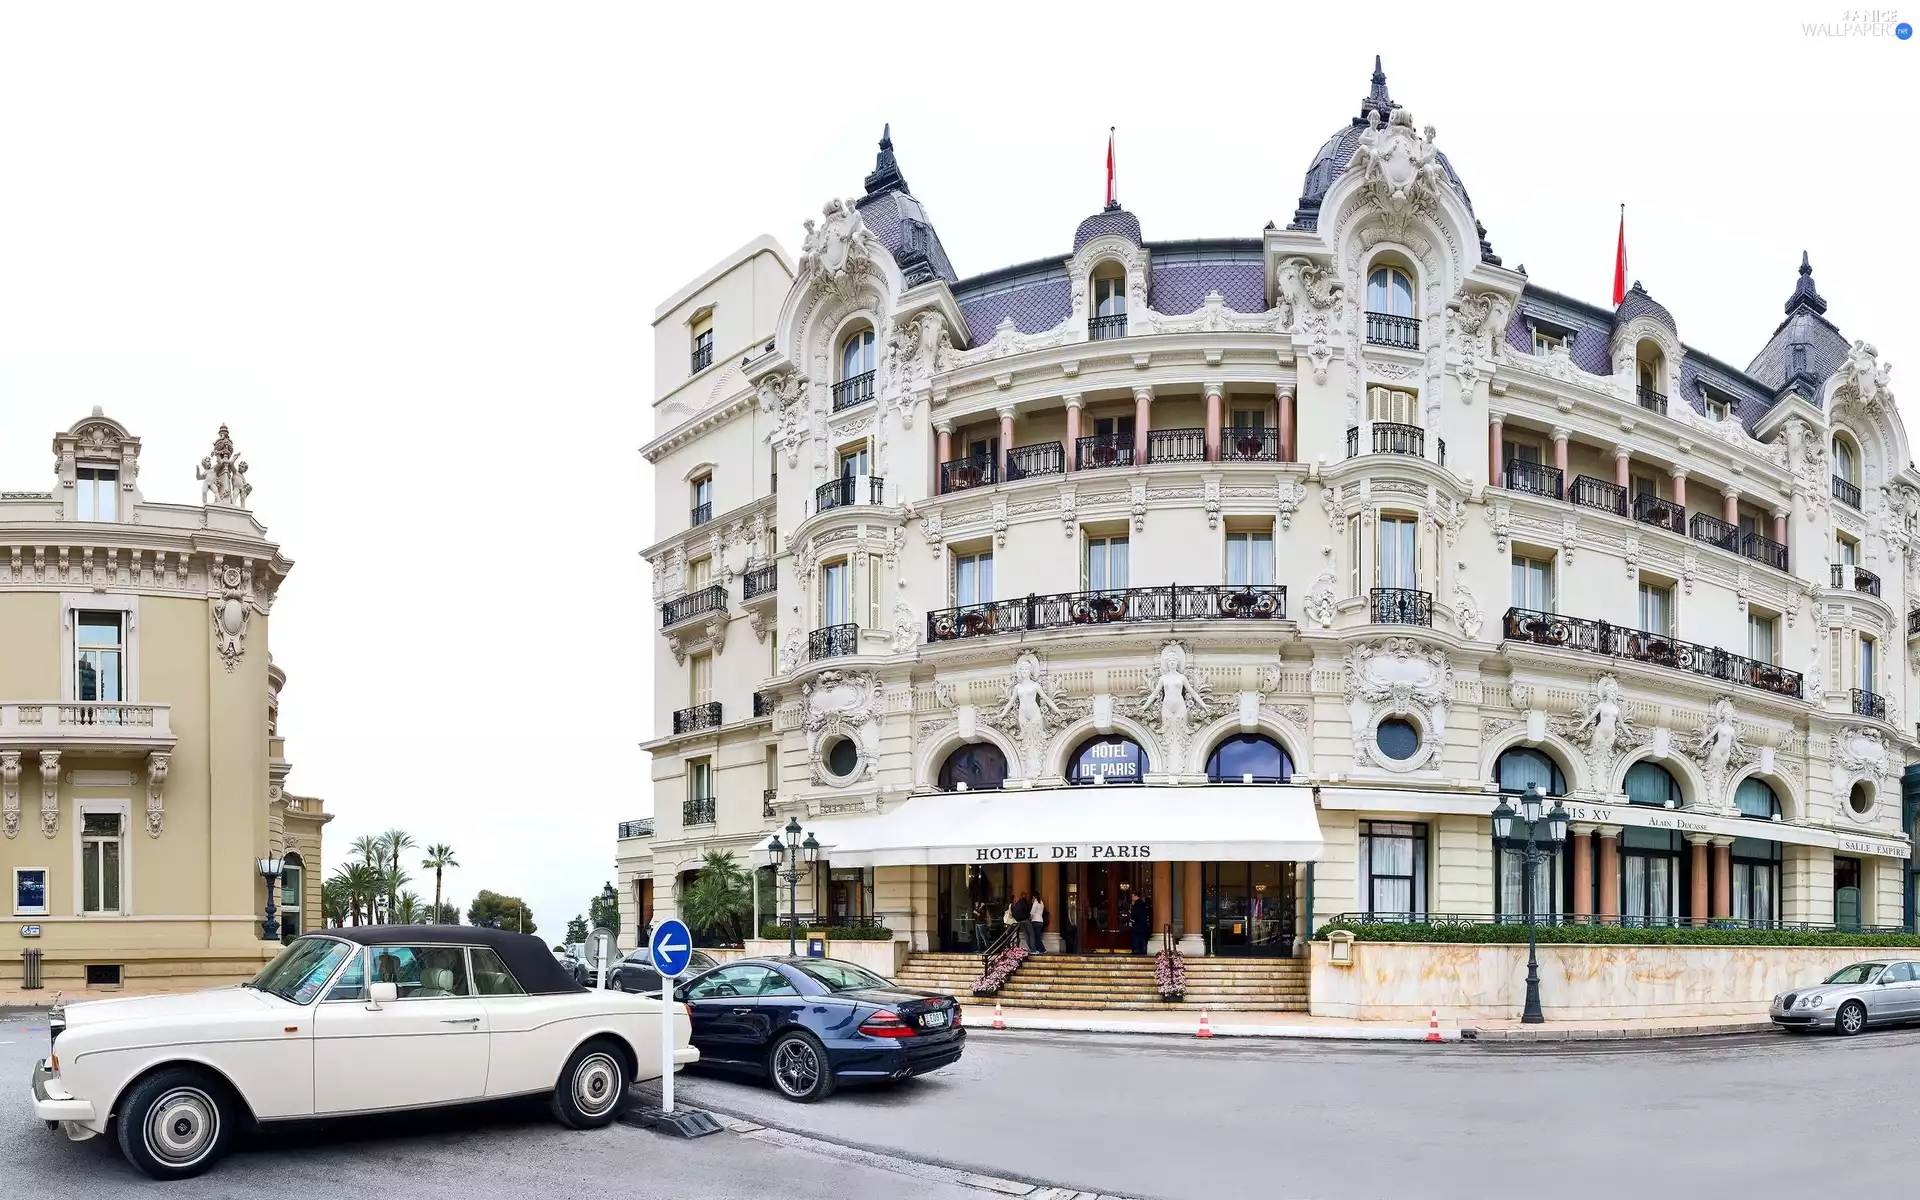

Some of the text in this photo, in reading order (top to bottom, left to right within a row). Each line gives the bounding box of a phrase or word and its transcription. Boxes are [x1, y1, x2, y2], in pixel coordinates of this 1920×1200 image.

[1092, 744, 1128, 758] HOTEL
[1081, 762, 1136, 776] DE PARIS
[1592, 809, 1611, 821] XV
[976, 845, 1151, 860] HOTEL DE PARIS
[1845, 841, 1906, 857] SALLE EMPIRE
